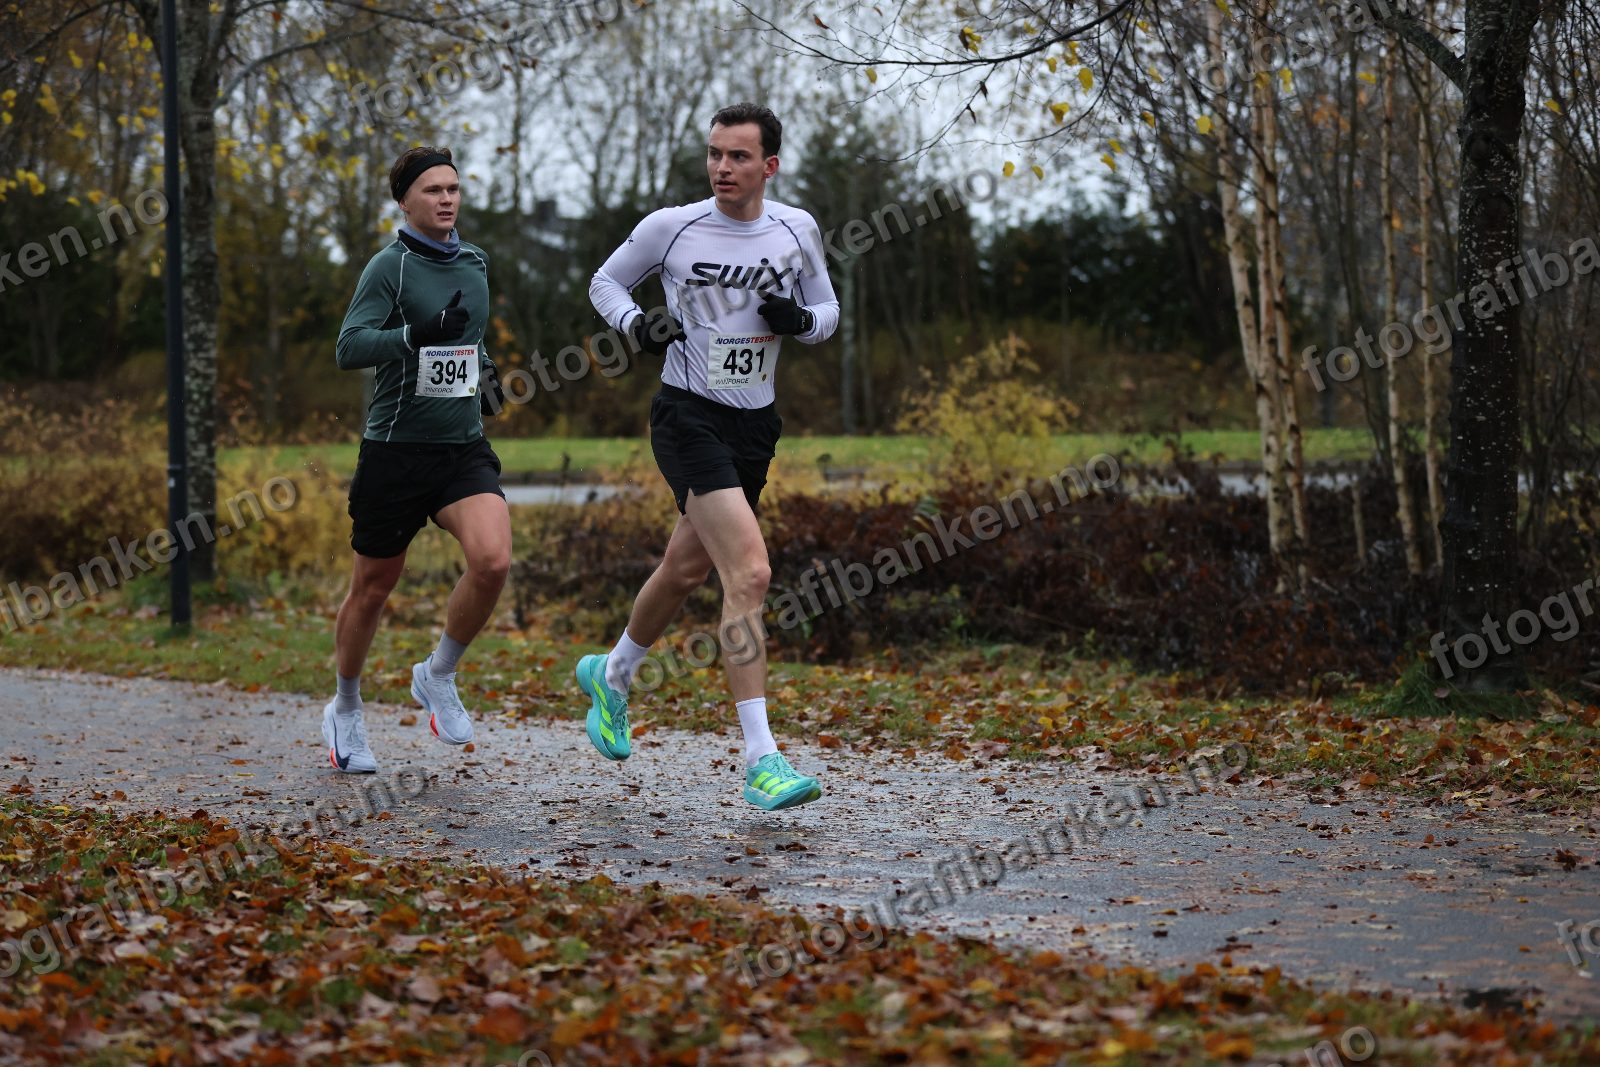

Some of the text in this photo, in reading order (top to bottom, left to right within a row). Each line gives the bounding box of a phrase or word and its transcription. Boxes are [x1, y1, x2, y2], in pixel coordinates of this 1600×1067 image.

[425, 349, 475, 357] NORGESTESTEN
[723, 347, 765, 375] 431
[431, 360, 467, 385] 394
